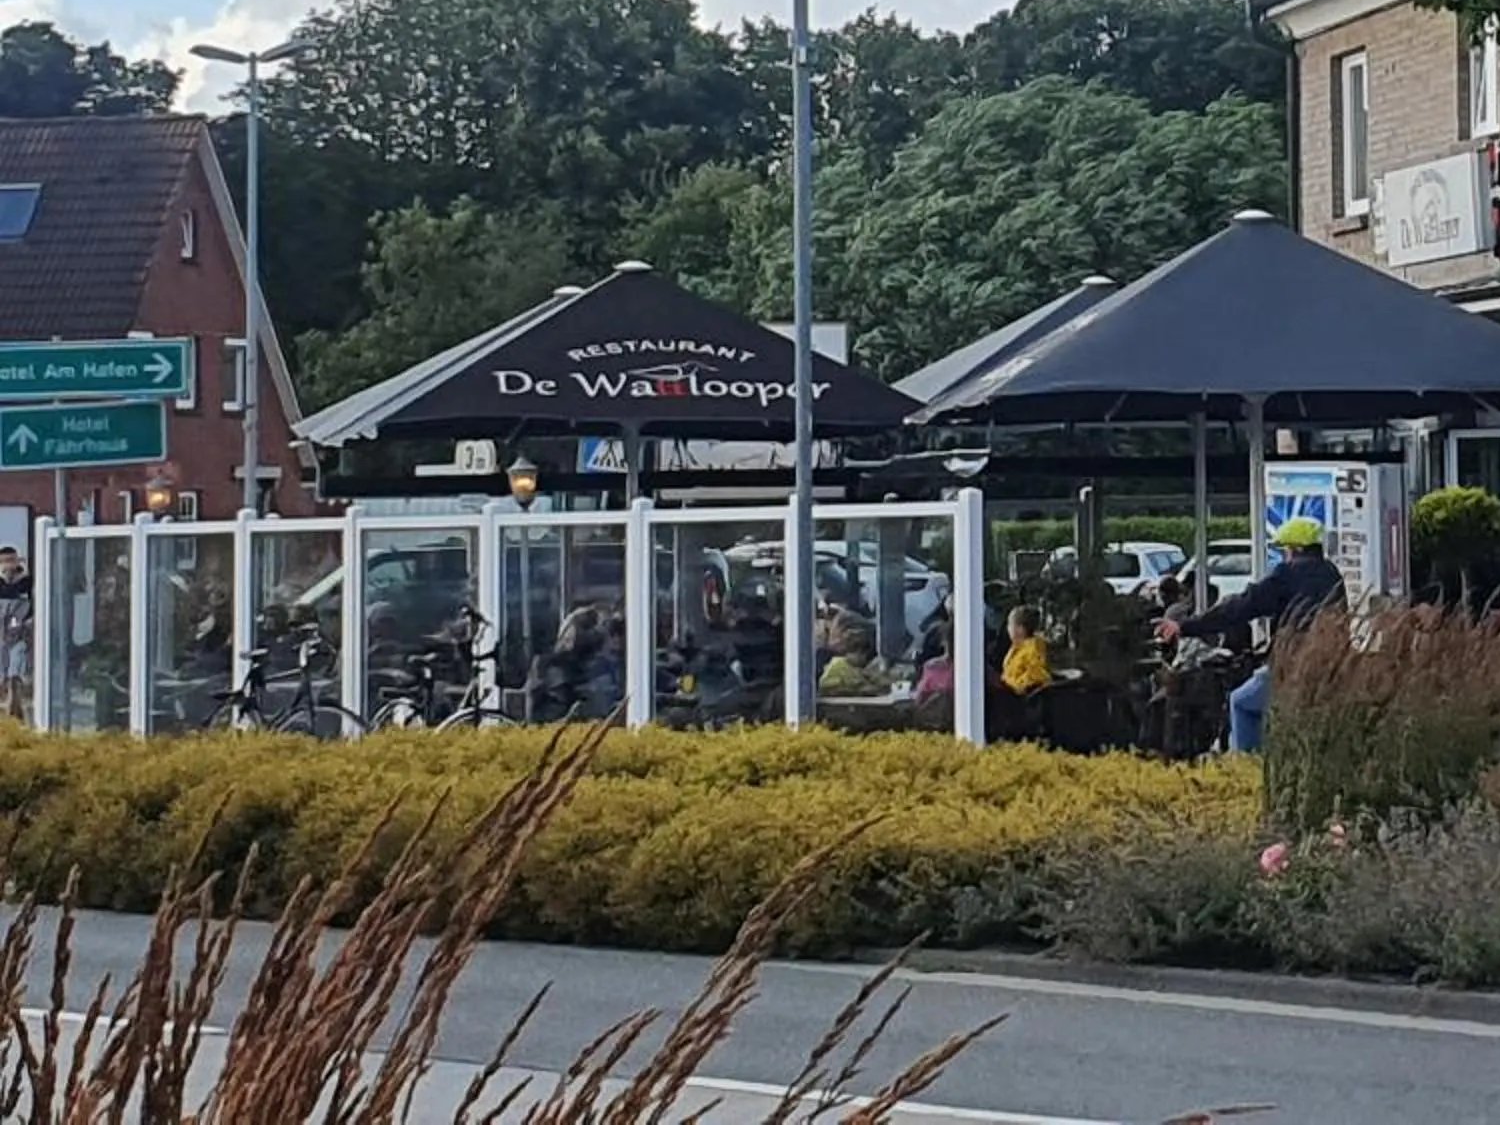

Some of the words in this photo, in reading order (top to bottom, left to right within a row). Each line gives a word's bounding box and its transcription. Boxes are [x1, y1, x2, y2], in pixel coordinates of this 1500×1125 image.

[567, 339, 755, 363] RESTAURANT
[0, 363, 36, 381] otel
[43, 363, 76, 380] Am
[83, 361, 138, 379] Hafen
[492, 370, 558, 396] De
